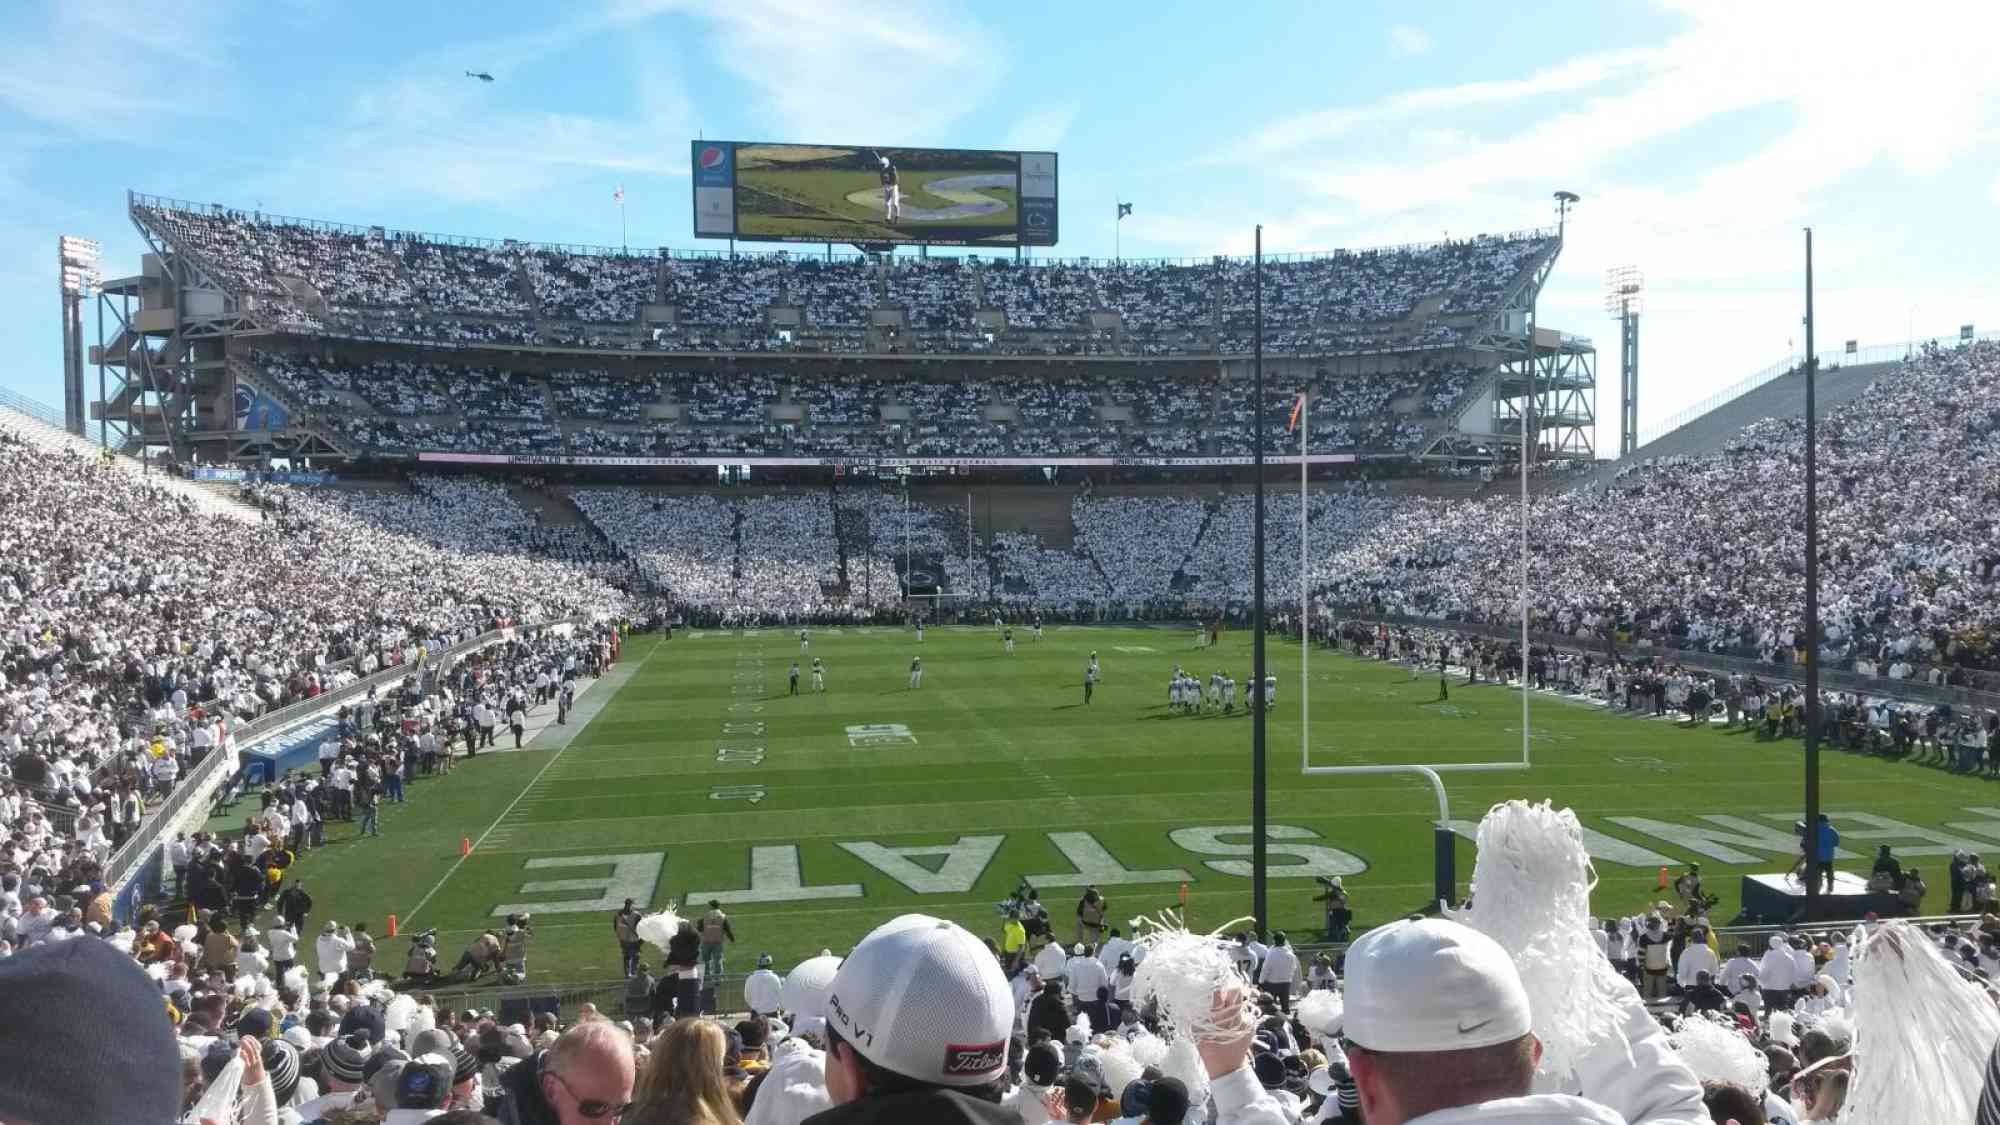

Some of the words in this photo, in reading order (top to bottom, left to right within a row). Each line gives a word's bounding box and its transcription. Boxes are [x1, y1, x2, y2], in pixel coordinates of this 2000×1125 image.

[507, 455, 560, 464] UNRIVALED
[488, 825, 1370, 916] STATE
[854, 1020, 873, 1047] V1
[949, 1049, 1004, 1071] Titleist
